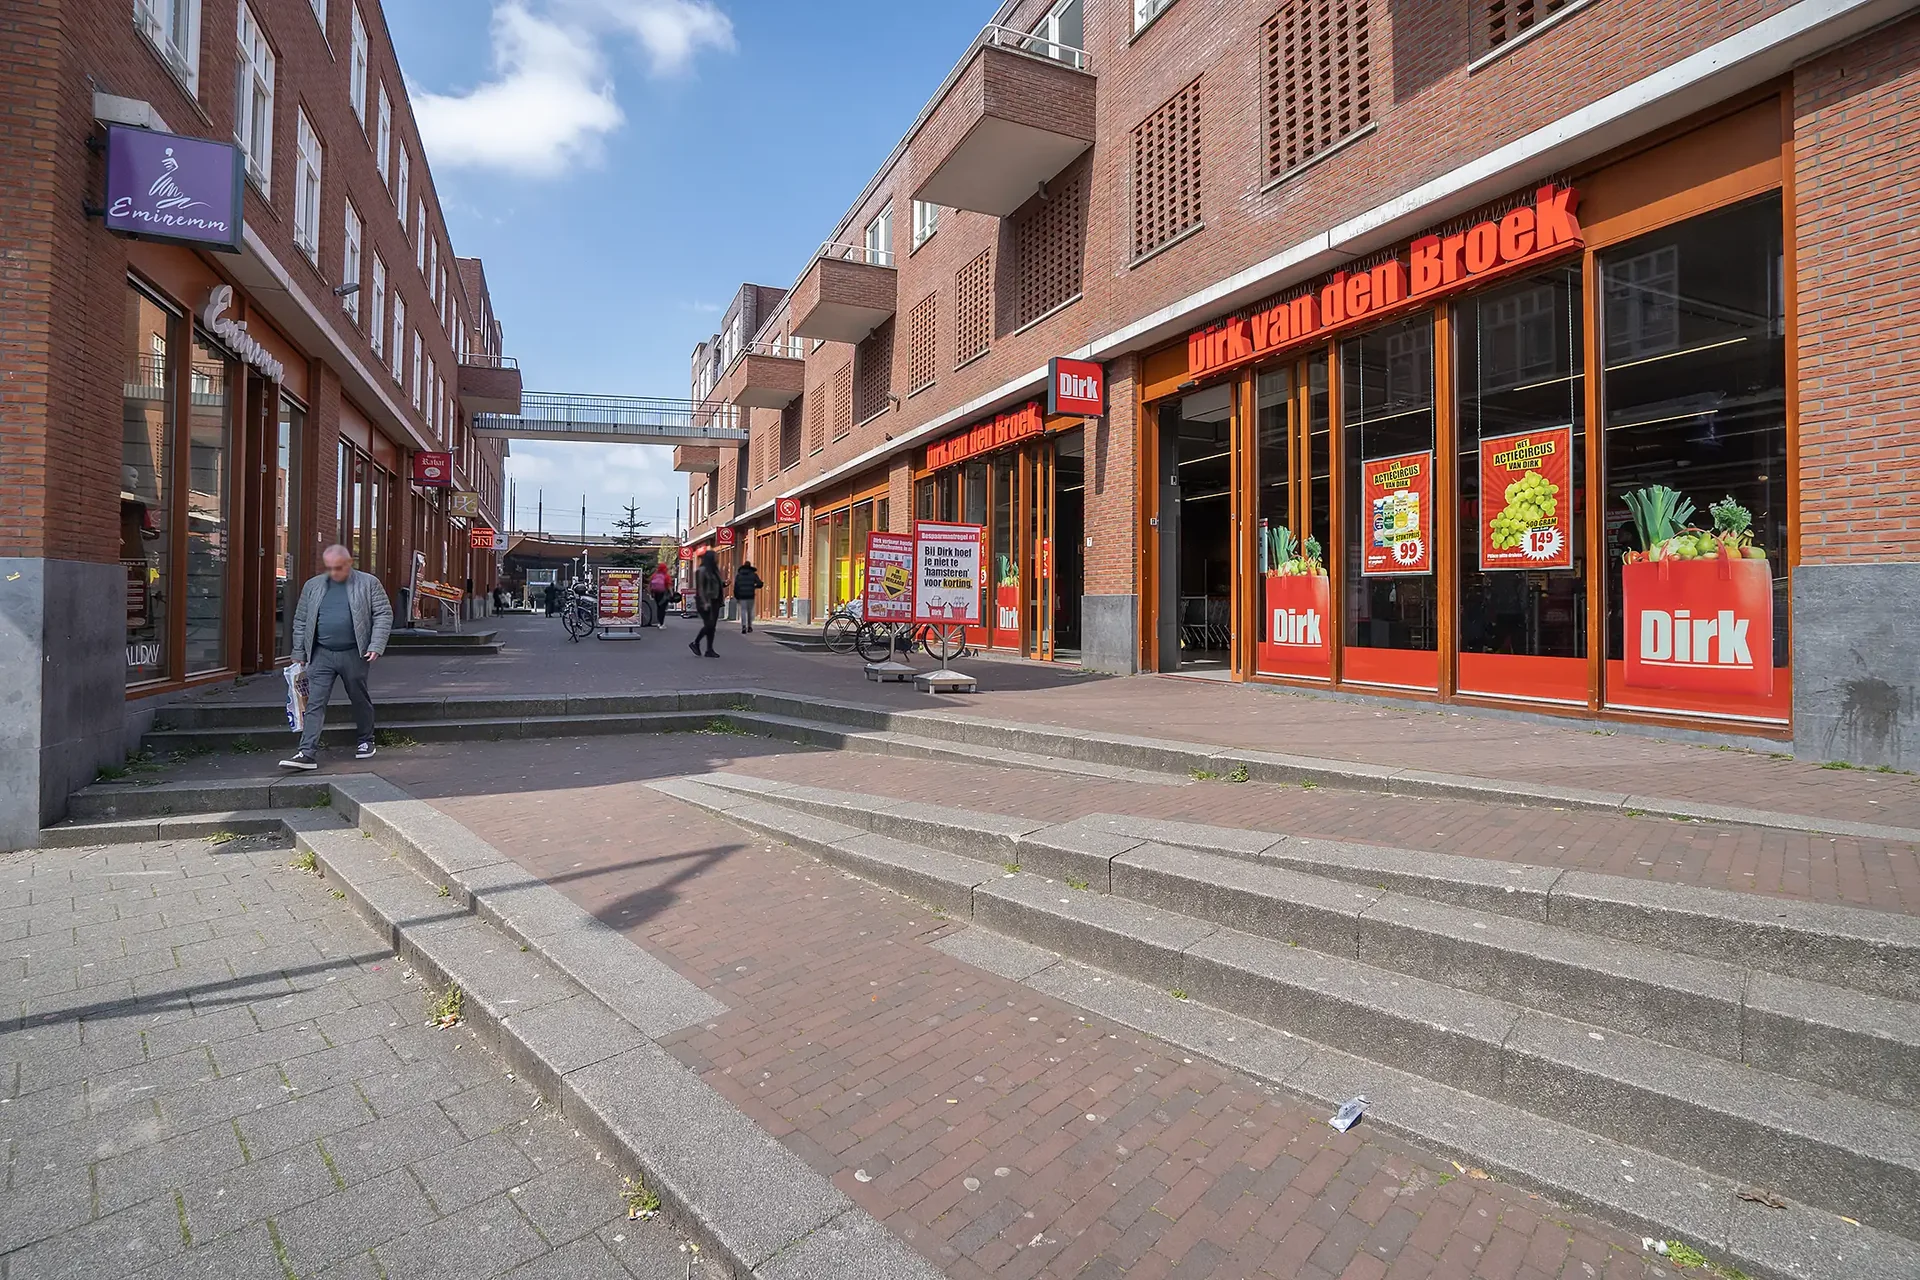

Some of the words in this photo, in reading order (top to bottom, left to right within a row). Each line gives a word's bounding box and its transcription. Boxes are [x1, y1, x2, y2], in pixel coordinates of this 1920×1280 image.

[109, 197, 228, 232] Eminemm
[1188, 316, 1252, 374] Dirk
[1251, 294, 1318, 351] van
[1321, 260, 1406, 327] den
[1411, 184, 1583, 296] Broek
[1059, 372, 1098, 399] Dirk
[949, 433, 969, 460] van
[970, 422, 995, 454] den
[995, 402, 1043, 443] Broek
[1494, 442, 1553, 465] ACTIECIRCUS
[1516, 440, 1528, 450] HET
[422, 458, 445, 467] Rabat
[1391, 462, 1400, 471] HET
[1508, 461, 1522, 470] VAN
[1522, 459, 1539, 469] DIRK
[1374, 465, 1419, 484] ACTIECIRCUS
[1385, 481, 1396, 489] VAN
[924, 546, 936, 556] Bij
[937, 546, 953, 557] Dirk
[954, 548, 972, 558] hoef
[1400, 542, 1418, 560] 99
[924, 557, 932, 567] je
[934, 557, 949, 567] niet
[950, 558, 959, 567] te
[924, 579, 942, 587] voor
[943, 579, 973, 589] korting.
[1000, 606, 1019, 629] Dirk
[1273, 608, 1322, 644] Dirk
[1640, 610, 1753, 664] Dirk
